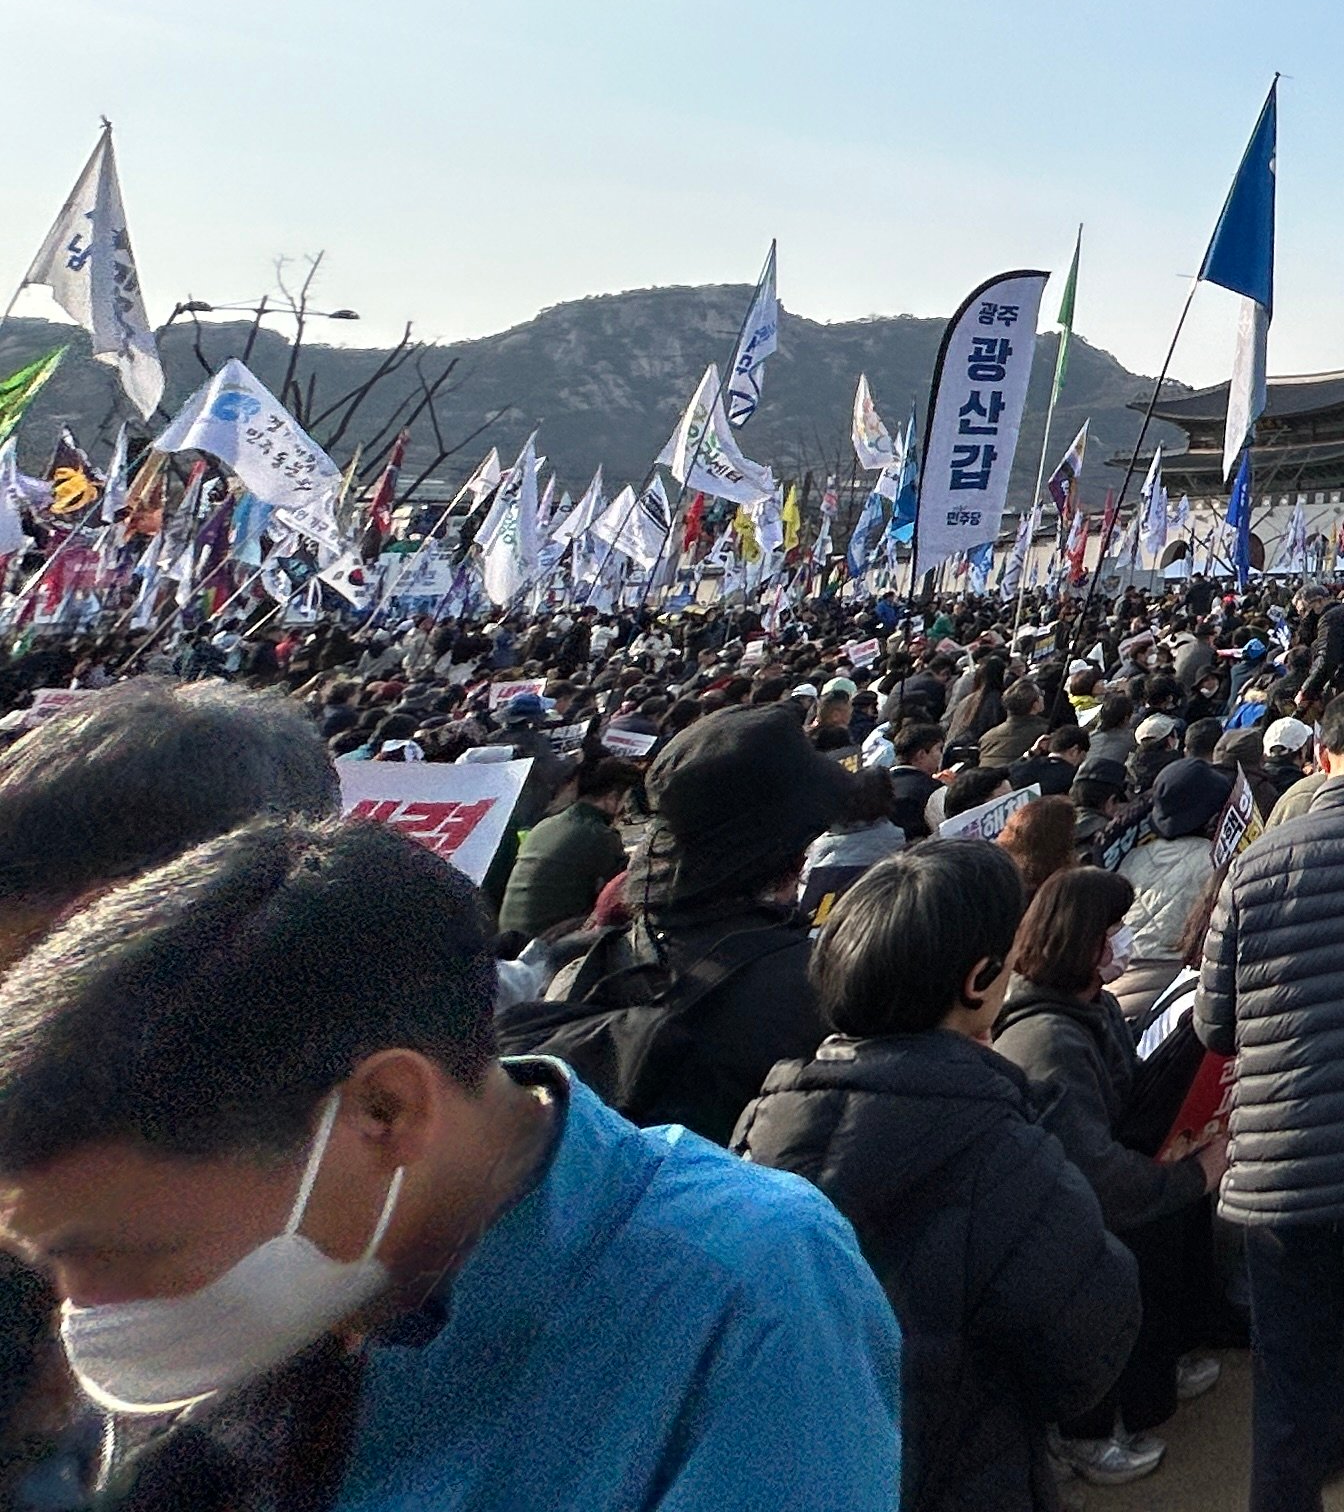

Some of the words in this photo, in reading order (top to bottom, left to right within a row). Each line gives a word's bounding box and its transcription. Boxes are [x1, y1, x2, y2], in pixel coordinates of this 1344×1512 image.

[978, 301, 1020, 327] 광주
[949, 336, 1013, 491] 광산갑
[946, 511, 982, 526] 민주당
